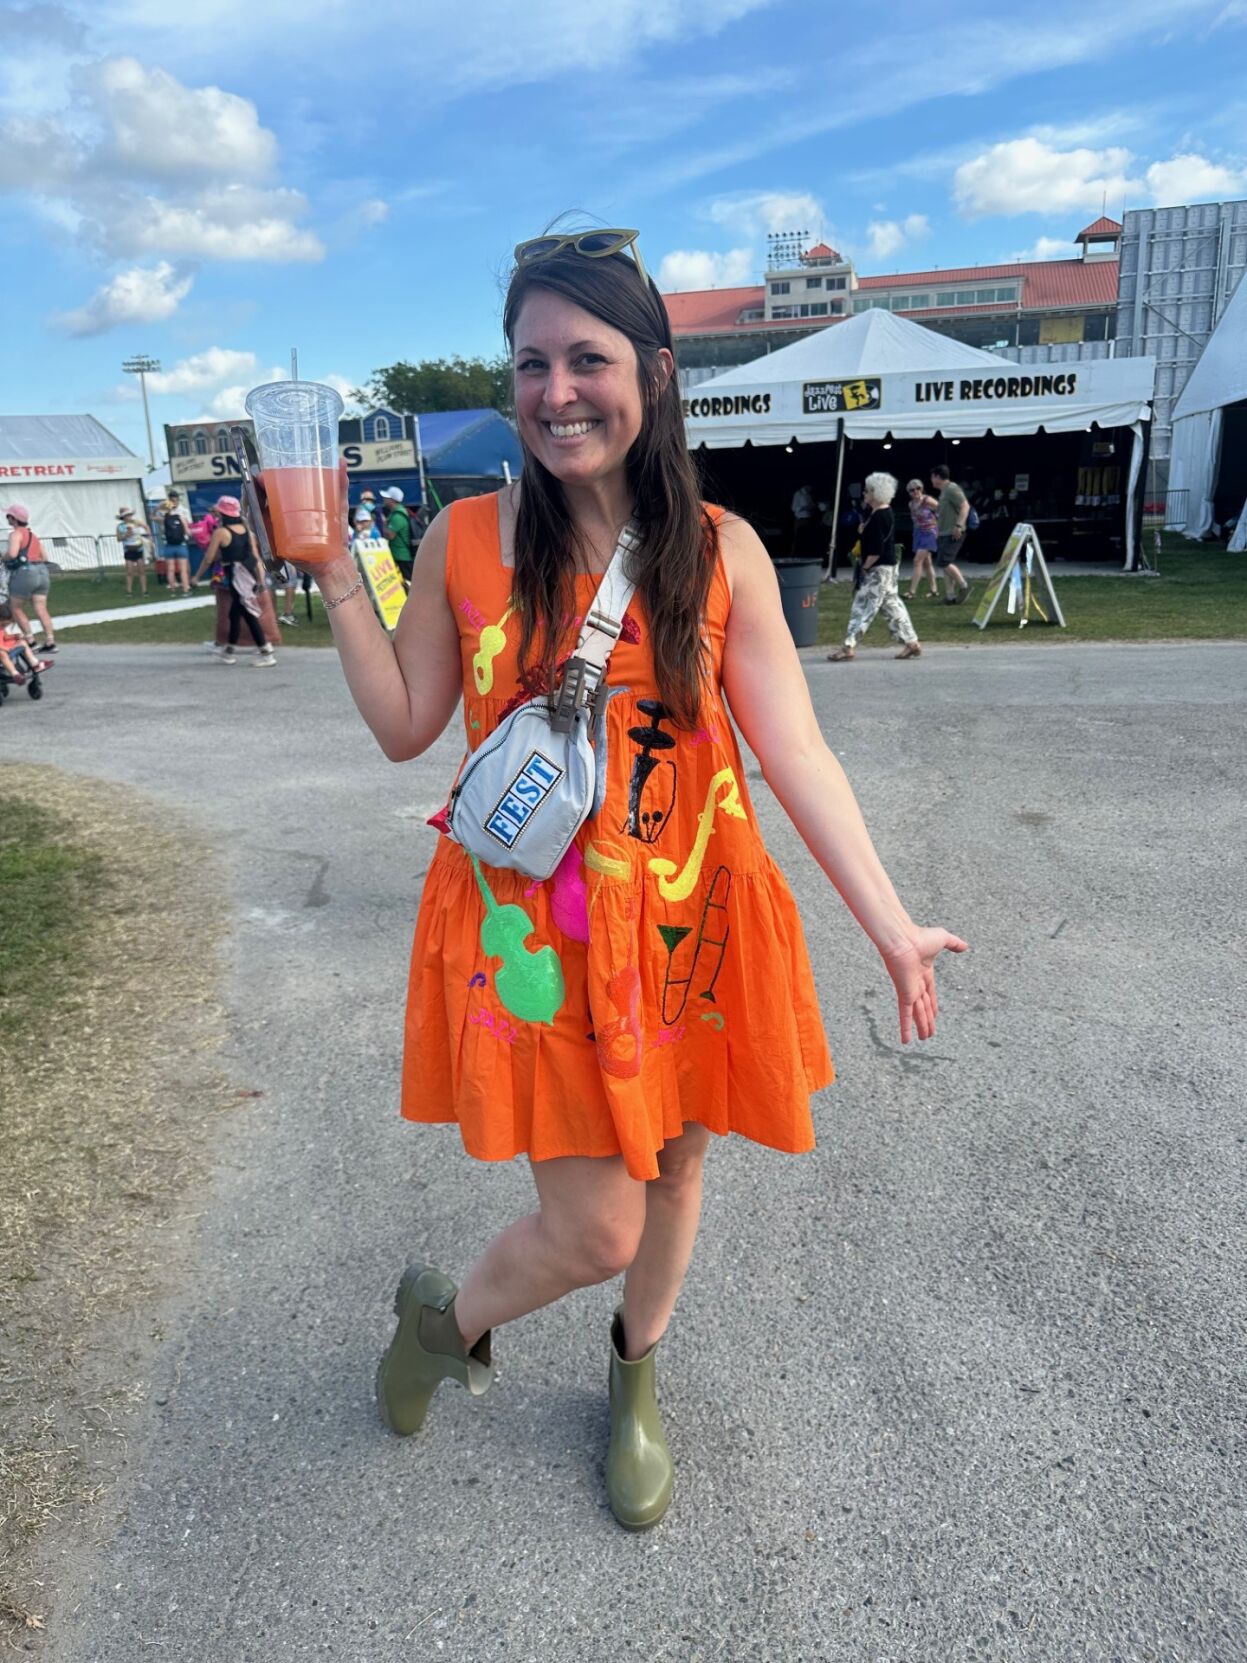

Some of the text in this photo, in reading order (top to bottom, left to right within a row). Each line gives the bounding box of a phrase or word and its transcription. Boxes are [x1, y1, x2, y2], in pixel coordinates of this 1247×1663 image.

[915, 373, 1076, 402] LIVE RECORDINGS
[684, 394, 771, 418] ECORDINGS
[0, 464, 75, 477] RETREAT
[489, 756, 555, 843] FEST
